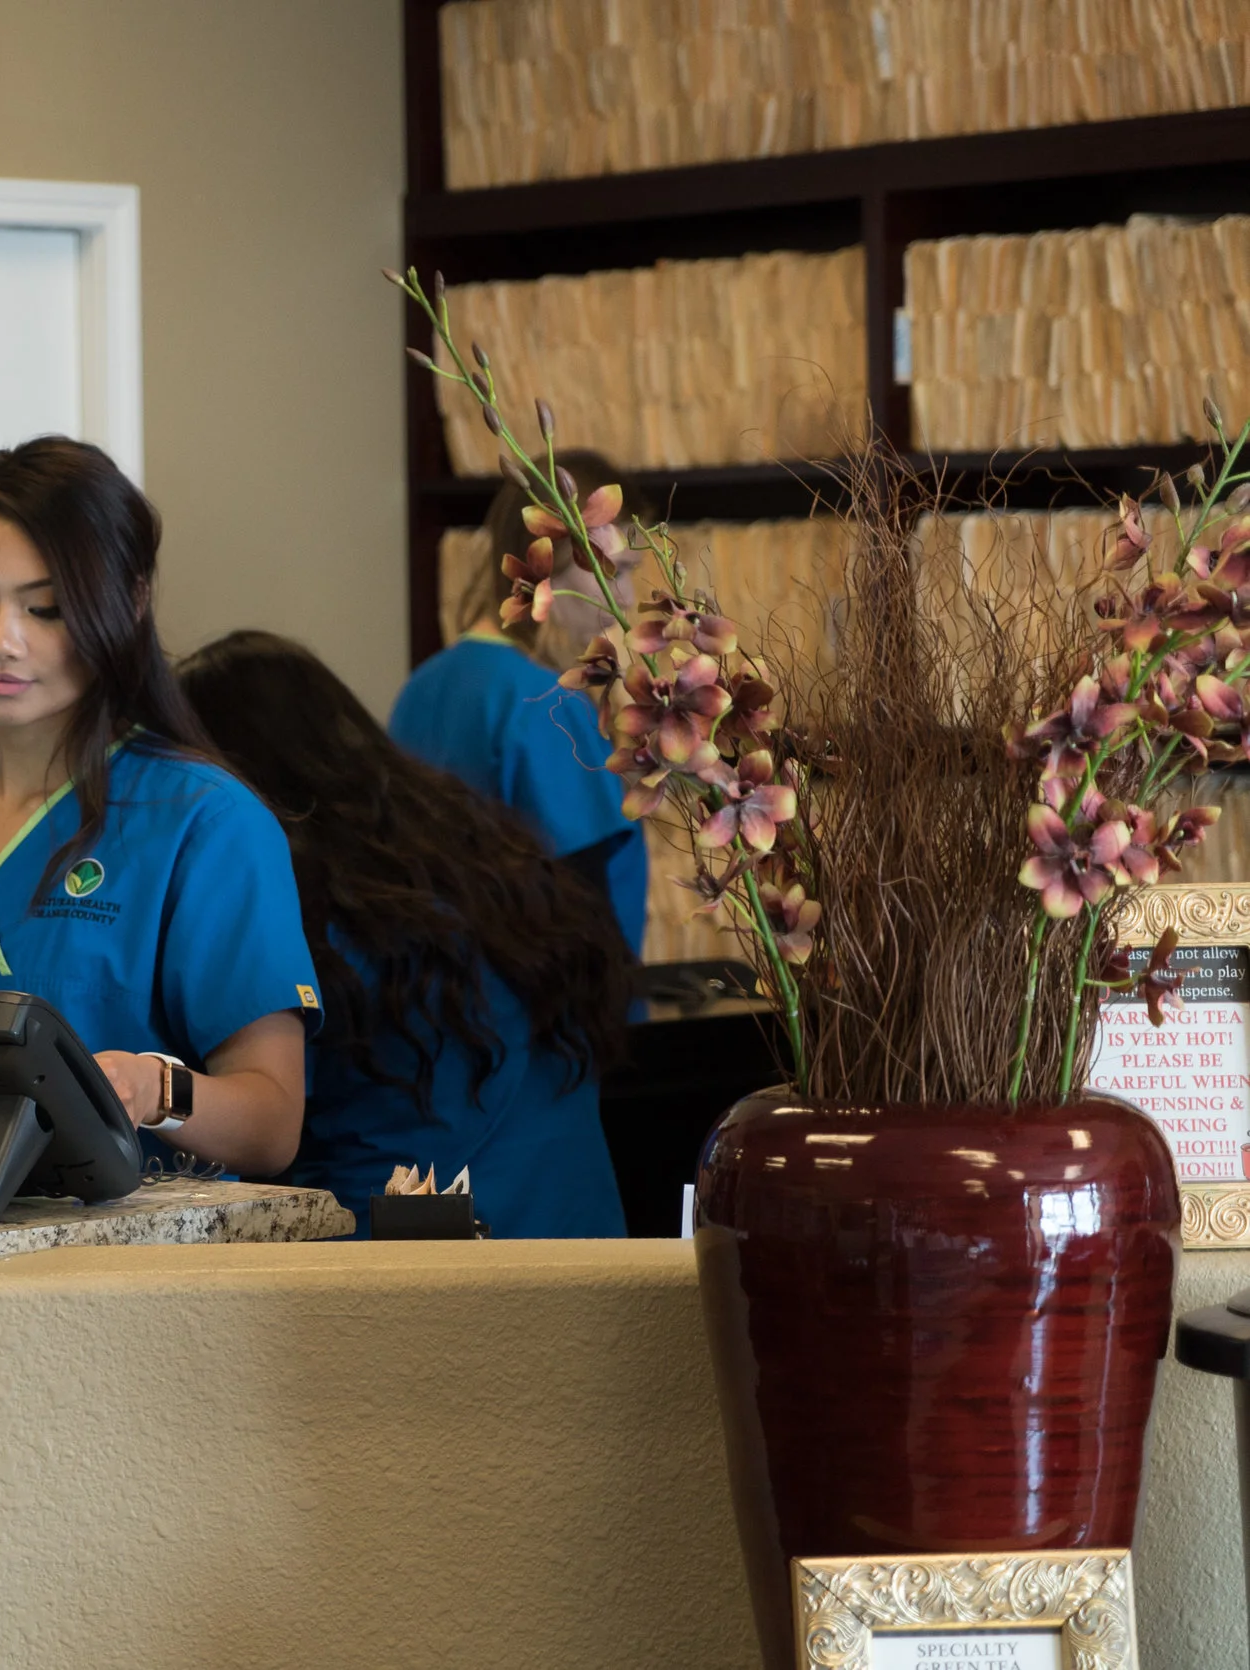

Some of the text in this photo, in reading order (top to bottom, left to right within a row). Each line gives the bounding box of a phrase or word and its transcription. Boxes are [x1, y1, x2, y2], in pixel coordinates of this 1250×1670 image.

[80, 898, 121, 914] HEALTH
[71, 910, 116, 926] COUNTY
[1176, 949, 1199, 960] not
[1203, 947, 1240, 960] allow
[1200, 965, 1213, 978] to
[1218, 965, 1246, 981] play
[1100, 1010, 1243, 1025] WARNNG! TEA
[1108, 1031, 1233, 1046] IS VERY HOT!
[1121, 1053, 1223, 1068] PLEASE BE
[1094, 1074, 1250, 1090] CAREFUL WHEN
[1230, 1096, 1244, 1110] &
[1157, 1117, 1227, 1133] NKING
[1176, 1141, 1237, 1155] HOT!!!
[917, 1642, 1018, 1658] SPECIALTY
